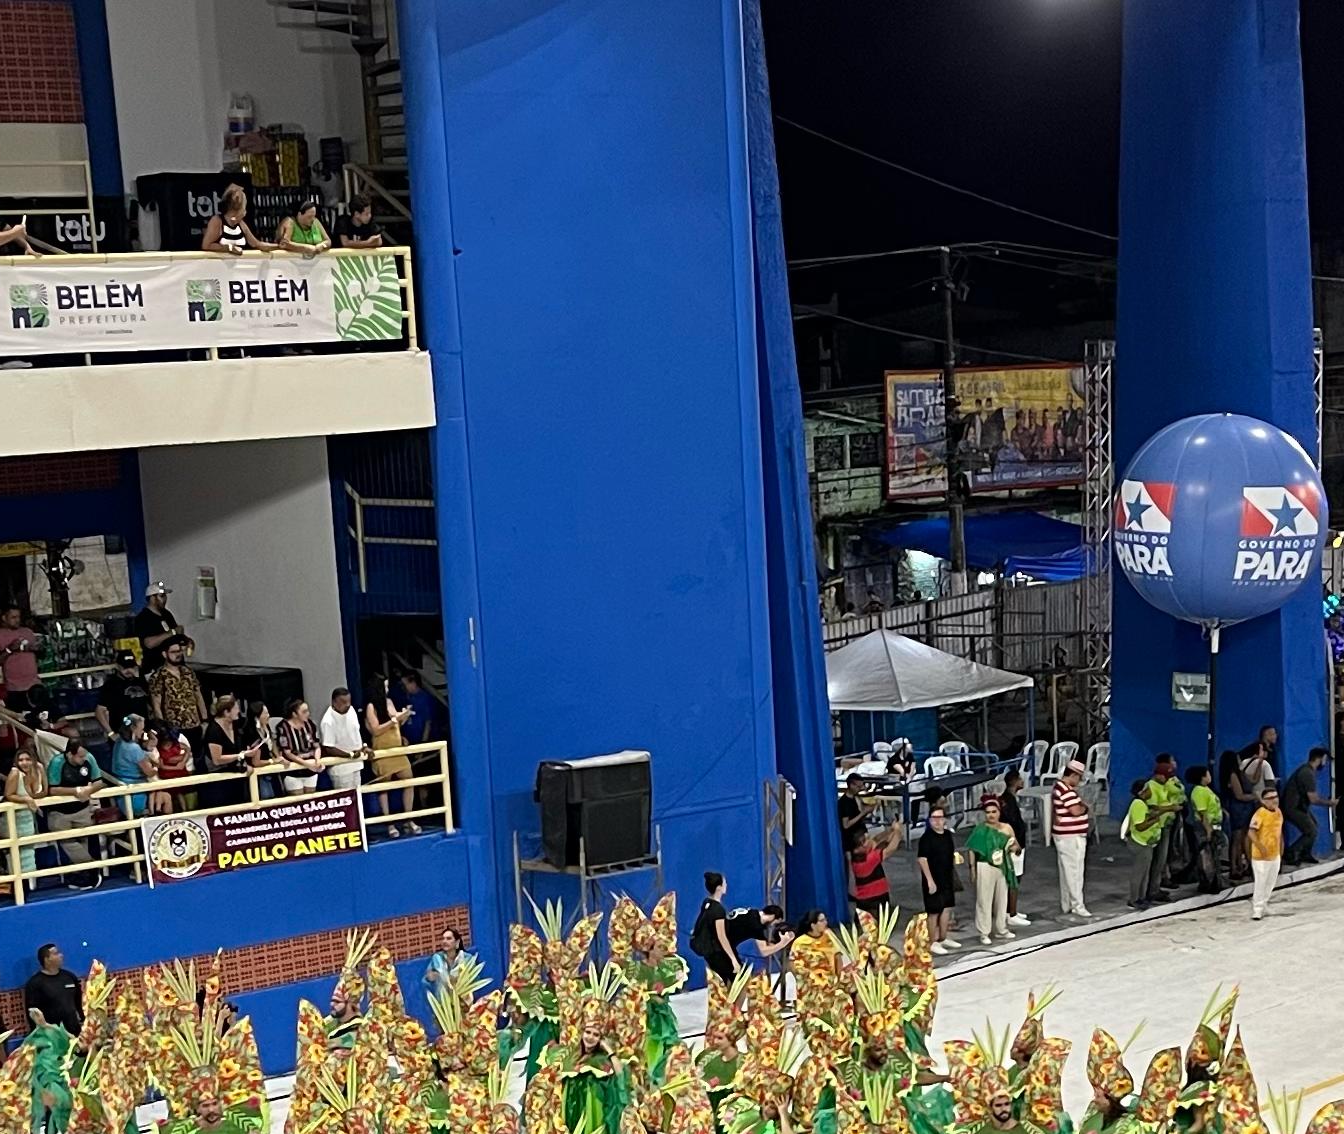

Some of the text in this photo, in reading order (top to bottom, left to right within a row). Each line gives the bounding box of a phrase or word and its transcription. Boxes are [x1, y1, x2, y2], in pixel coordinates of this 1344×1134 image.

[187, 191, 223, 218] tat
[55, 214, 106, 243] tatu
[55, 279, 144, 310] BELÉM
[228, 275, 309, 304] BELÉM
[59, 313, 147, 325] PREFEITURA
[231, 308, 312, 319] PREFEITURA
[1151, 535, 1169, 545] DO
[1239, 538, 1317, 550] GOVERNO DO
[213, 817, 223, 827] A
[269, 806, 303, 820] QUEM
[303, 800, 327, 813] SÃO
[328, 796, 353, 809] ELES
[218, 831, 362, 869] PAULO ANETE
